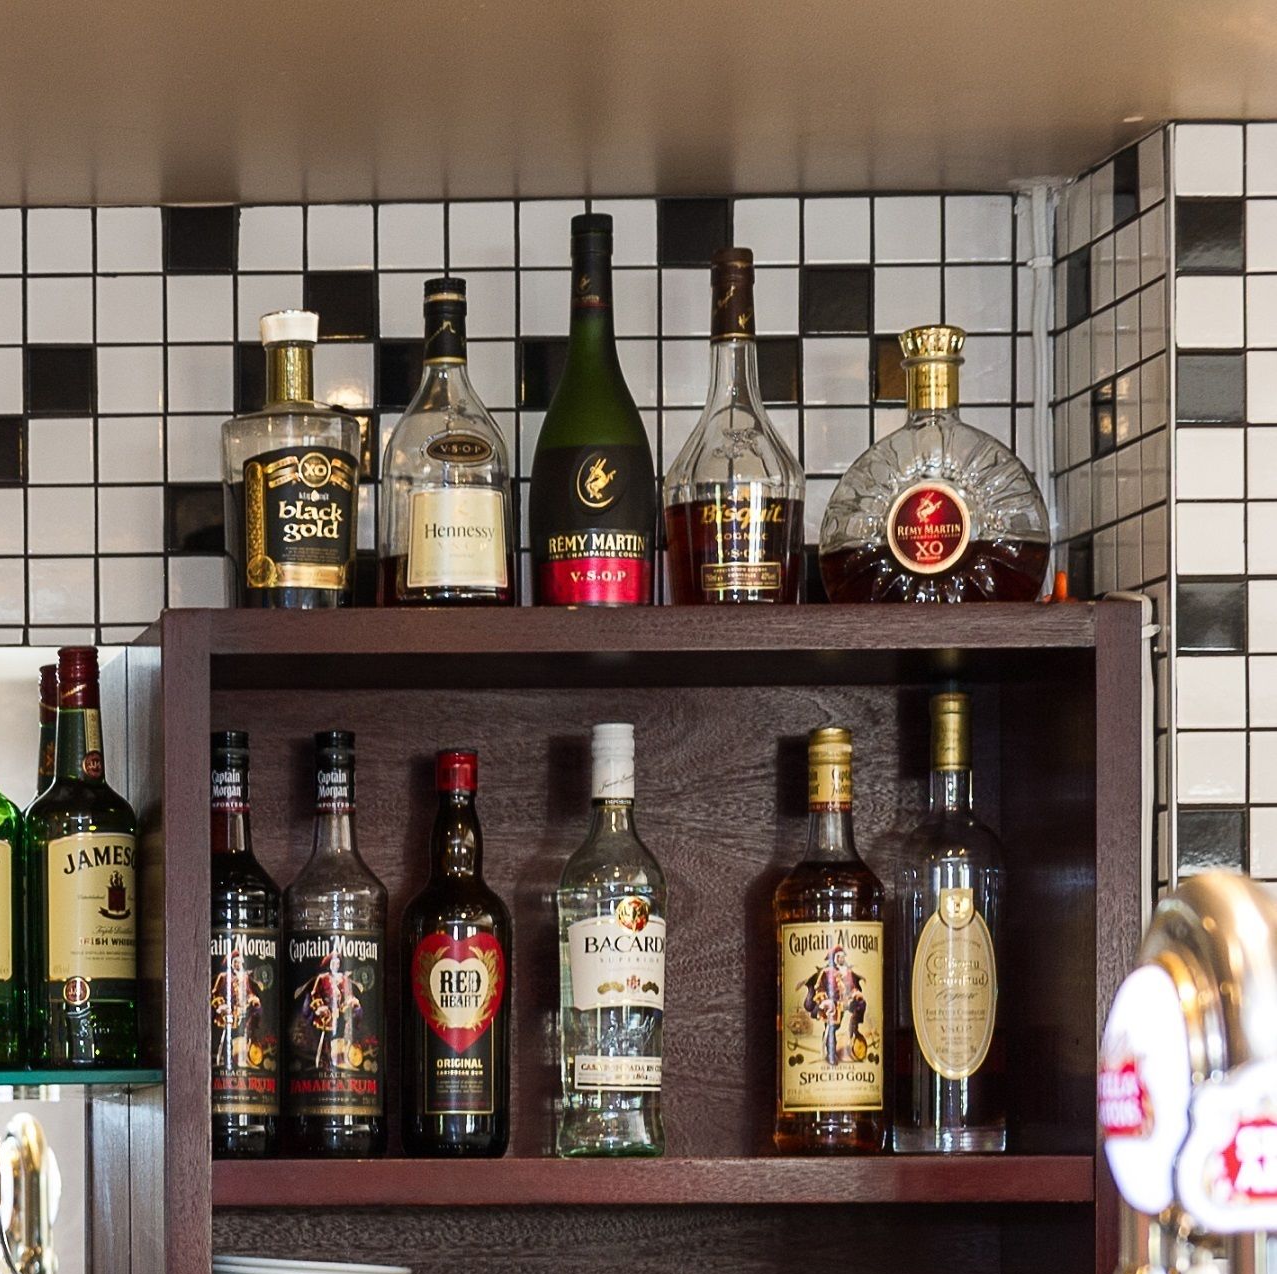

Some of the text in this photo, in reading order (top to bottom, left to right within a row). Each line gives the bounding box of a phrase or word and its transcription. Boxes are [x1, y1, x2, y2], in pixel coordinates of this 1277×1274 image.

[303, 462, 325, 478] XO
[278, 499, 343, 523] black
[282, 519, 340, 543] gold
[424, 523, 495, 541] Hennessy
[924, 522, 961, 535] MARTIN
[592, 533, 645, 551] MARTIN
[916, 540, 944, 556] XO
[567, 551, 615, 559] CHAMPAGNE
[317, 769, 347, 785] Captain
[212, 785, 241, 798] Morgan
[318, 786, 348, 799] Morgan
[64, 845, 136, 875] JAMES
[233, 935, 277, 960] Morgan
[289, 935, 379, 962] Captain Morgan
[788, 929, 879, 956] Captain Morgan
[439, 969, 482, 993] RED
[440, 994, 482, 1008] HEART
[436, 1058, 483, 1069] ORIGINAL
[318, 1070, 347, 1078] BLACK
[799, 1070, 875, 1086] SPICED GOLD
[248, 1078, 276, 1094] RUM
[290, 1078, 378, 1094] JAMAICA RUM
